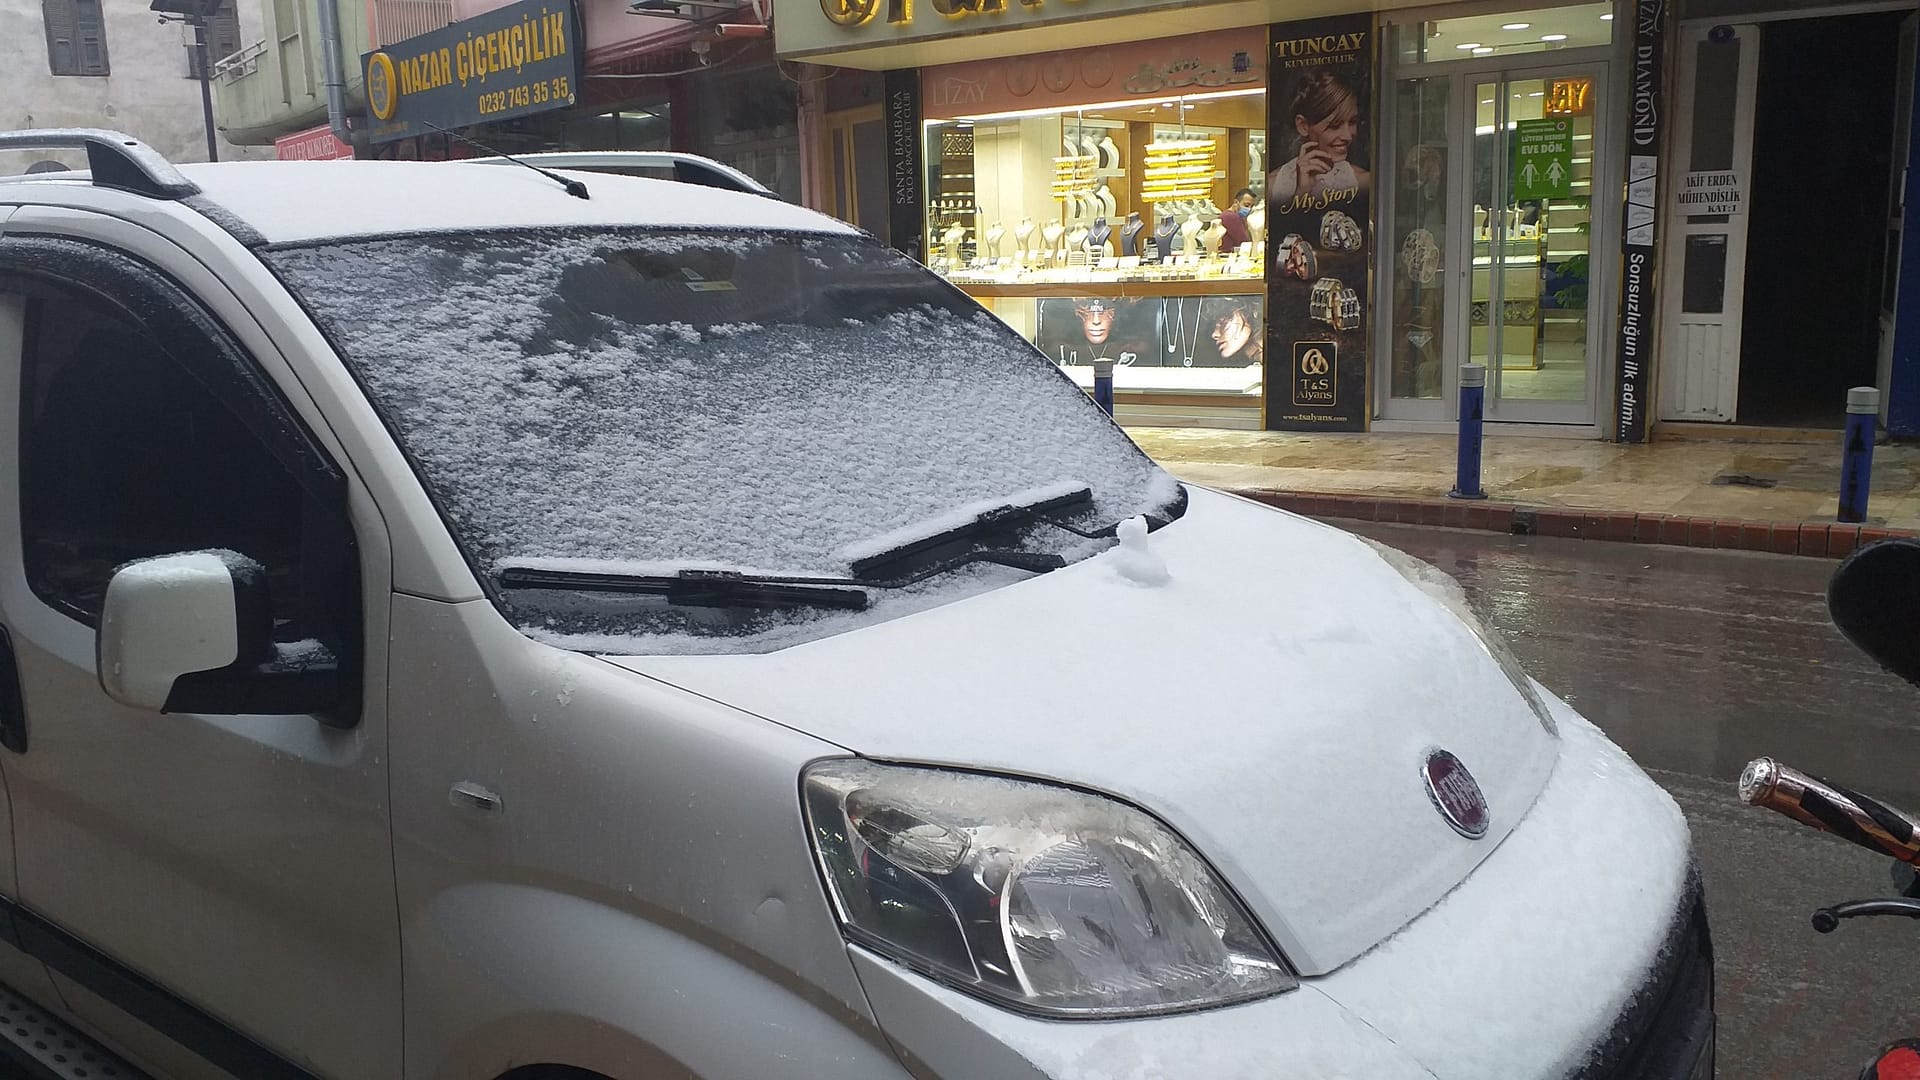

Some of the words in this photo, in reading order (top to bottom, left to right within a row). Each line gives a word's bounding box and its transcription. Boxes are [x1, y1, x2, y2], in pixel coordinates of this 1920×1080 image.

[400, 48, 452, 95] NAZAR
[456, 8, 566, 88] ÇİÇEKÇİLİK
[1274, 32, 1366, 58] TUNCAY
[1284, 54, 1355, 69] KUYUMCULUK
[479, 90, 506, 114] 0232
[508, 86, 529, 109] 743
[533, 82, 549, 105] 35
[553, 77, 569, 100] 35
[1633, 45, 1658, 146] DIAMOND
[893, 91, 904, 156] BARBARA
[904, 120, 913, 166] RACQUET
[1521, 145, 1540, 155] EVE
[1541, 142, 1566, 154] DÖN.
[895, 160, 906, 204] SANTA
[906, 176, 914, 204] POLO
[1707, 174, 1737, 187] ERDEN
[1280, 192, 1315, 215] My
[1315, 186, 1359, 210] Story
[1678, 188, 1740, 204] MÜHENDİSLİK
[1623, 253, 1645, 356] Sonsuzluğun
[1623, 359, 1640, 380] ilk
[1296, 390, 1333, 401] Alyans
[1283, 413, 1348, 423] www.tsalyans.com
